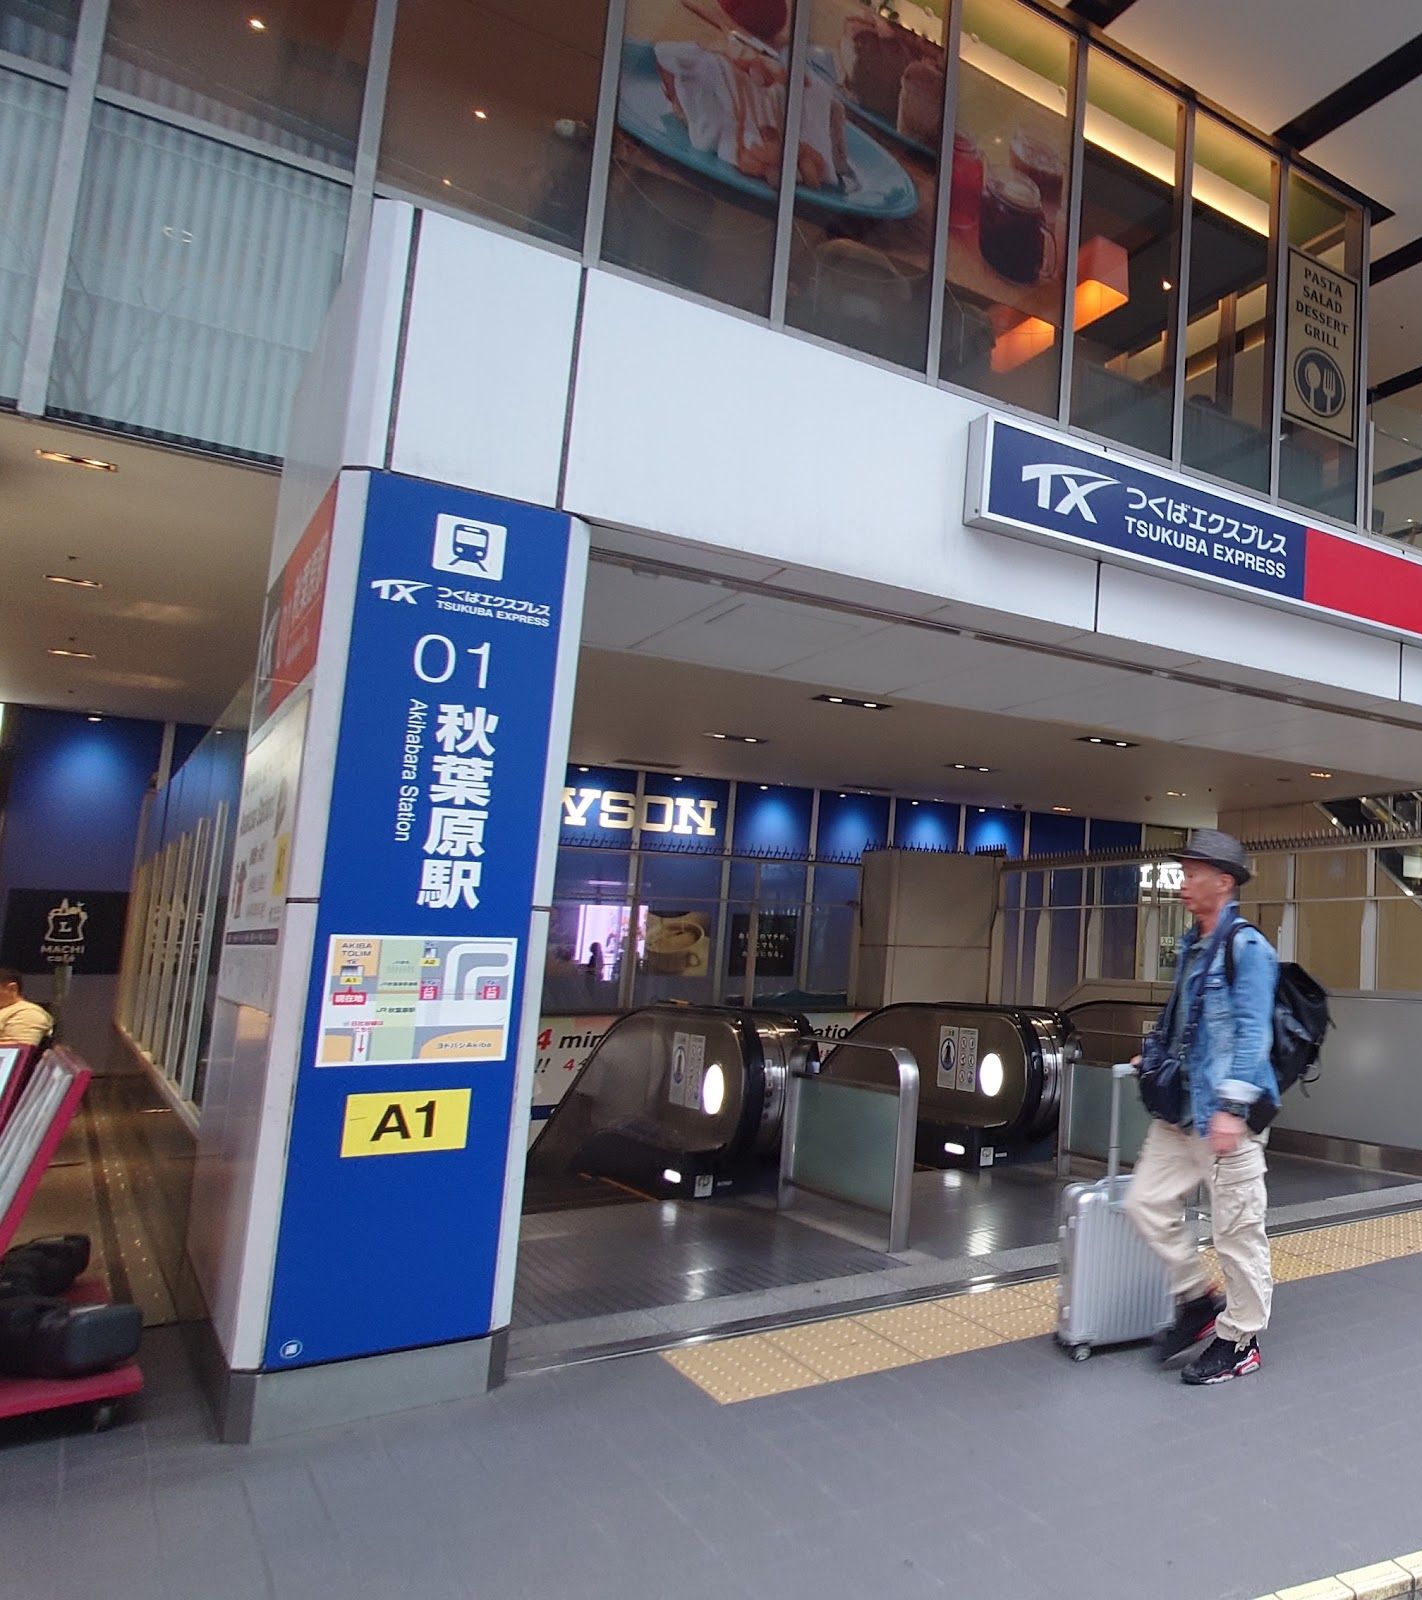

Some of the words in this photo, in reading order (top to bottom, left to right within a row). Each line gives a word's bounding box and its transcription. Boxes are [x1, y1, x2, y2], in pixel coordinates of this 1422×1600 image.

[1304, 267, 1342, 297] PASTA
[1303, 286, 1342, 314] SALAD
[1296, 300, 1349, 335] DESSERT
[1304, 323, 1340, 350] GRILL
[1022, 463, 1121, 524] TX
[1126, 486, 1287, 557] つくばエクスプレス
[1124, 515, 1208, 557] TSUKUBA
[1213, 544, 1287, 579] EXPRESS
[371, 579, 433, 604] TX
[437, 587, 550, 616] つくばエクスプレス
[436, 600, 493, 618] TSUKUBA
[496, 610, 550, 627] EXPRESS
[413, 634, 491, 689] 01
[401, 698, 429, 780] Akihabara
[394, 785, 419, 843] Station
[416, 704, 500, 910] 秋葉原駅
[41, 945, 85, 954] MACHI
[537, 1028, 552, 1050] 4
[563, 1058, 575, 1072] 4
[370, 1100, 436, 1141] A1
